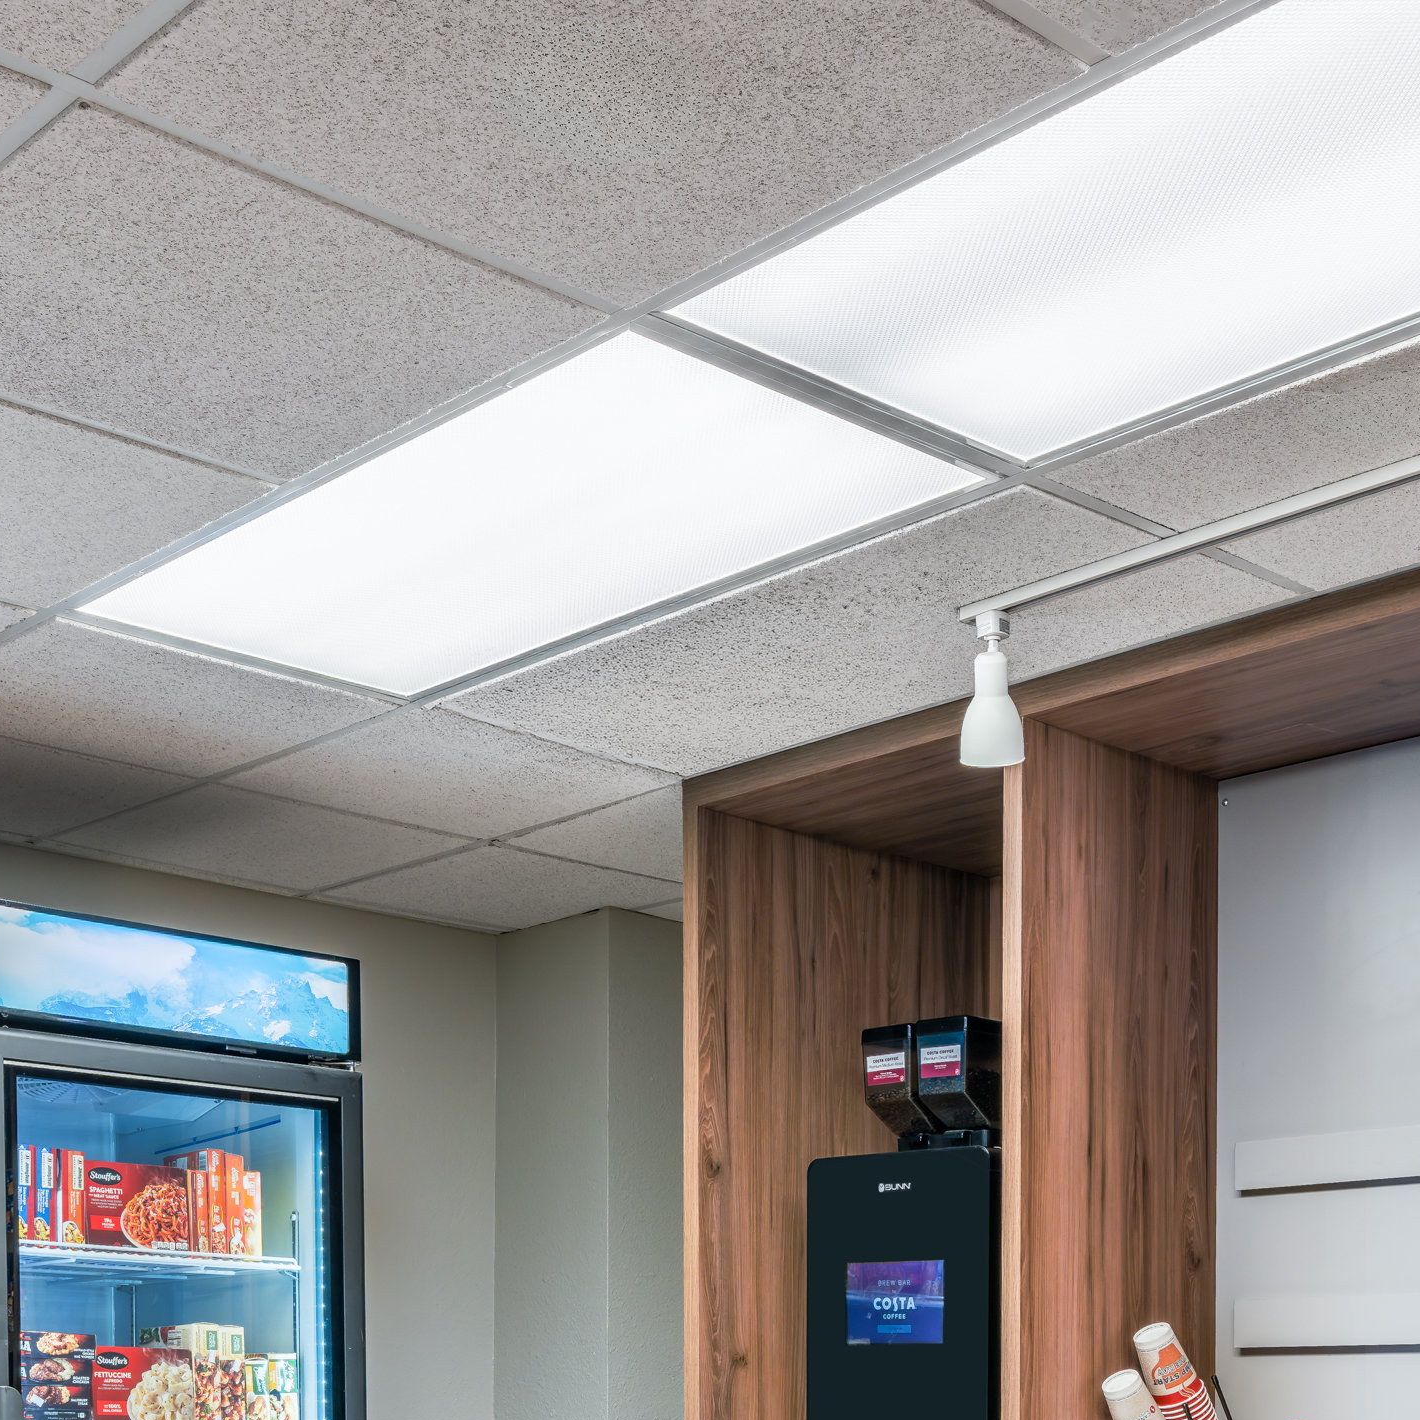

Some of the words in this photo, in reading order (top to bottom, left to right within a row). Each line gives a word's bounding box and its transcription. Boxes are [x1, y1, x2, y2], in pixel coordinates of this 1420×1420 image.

[89, 1169, 122, 1182] Stouffer's
[89, 1186, 123, 1195] SPAGHETTI
[877, 1279, 896, 1287] BREW
[897, 1279, 911, 1287] BAR
[873, 1297, 915, 1312] COSTA
[96, 1354, 129, 1367] Stouffer's
[94, 1371, 132, 1379] FETTUCCINE
